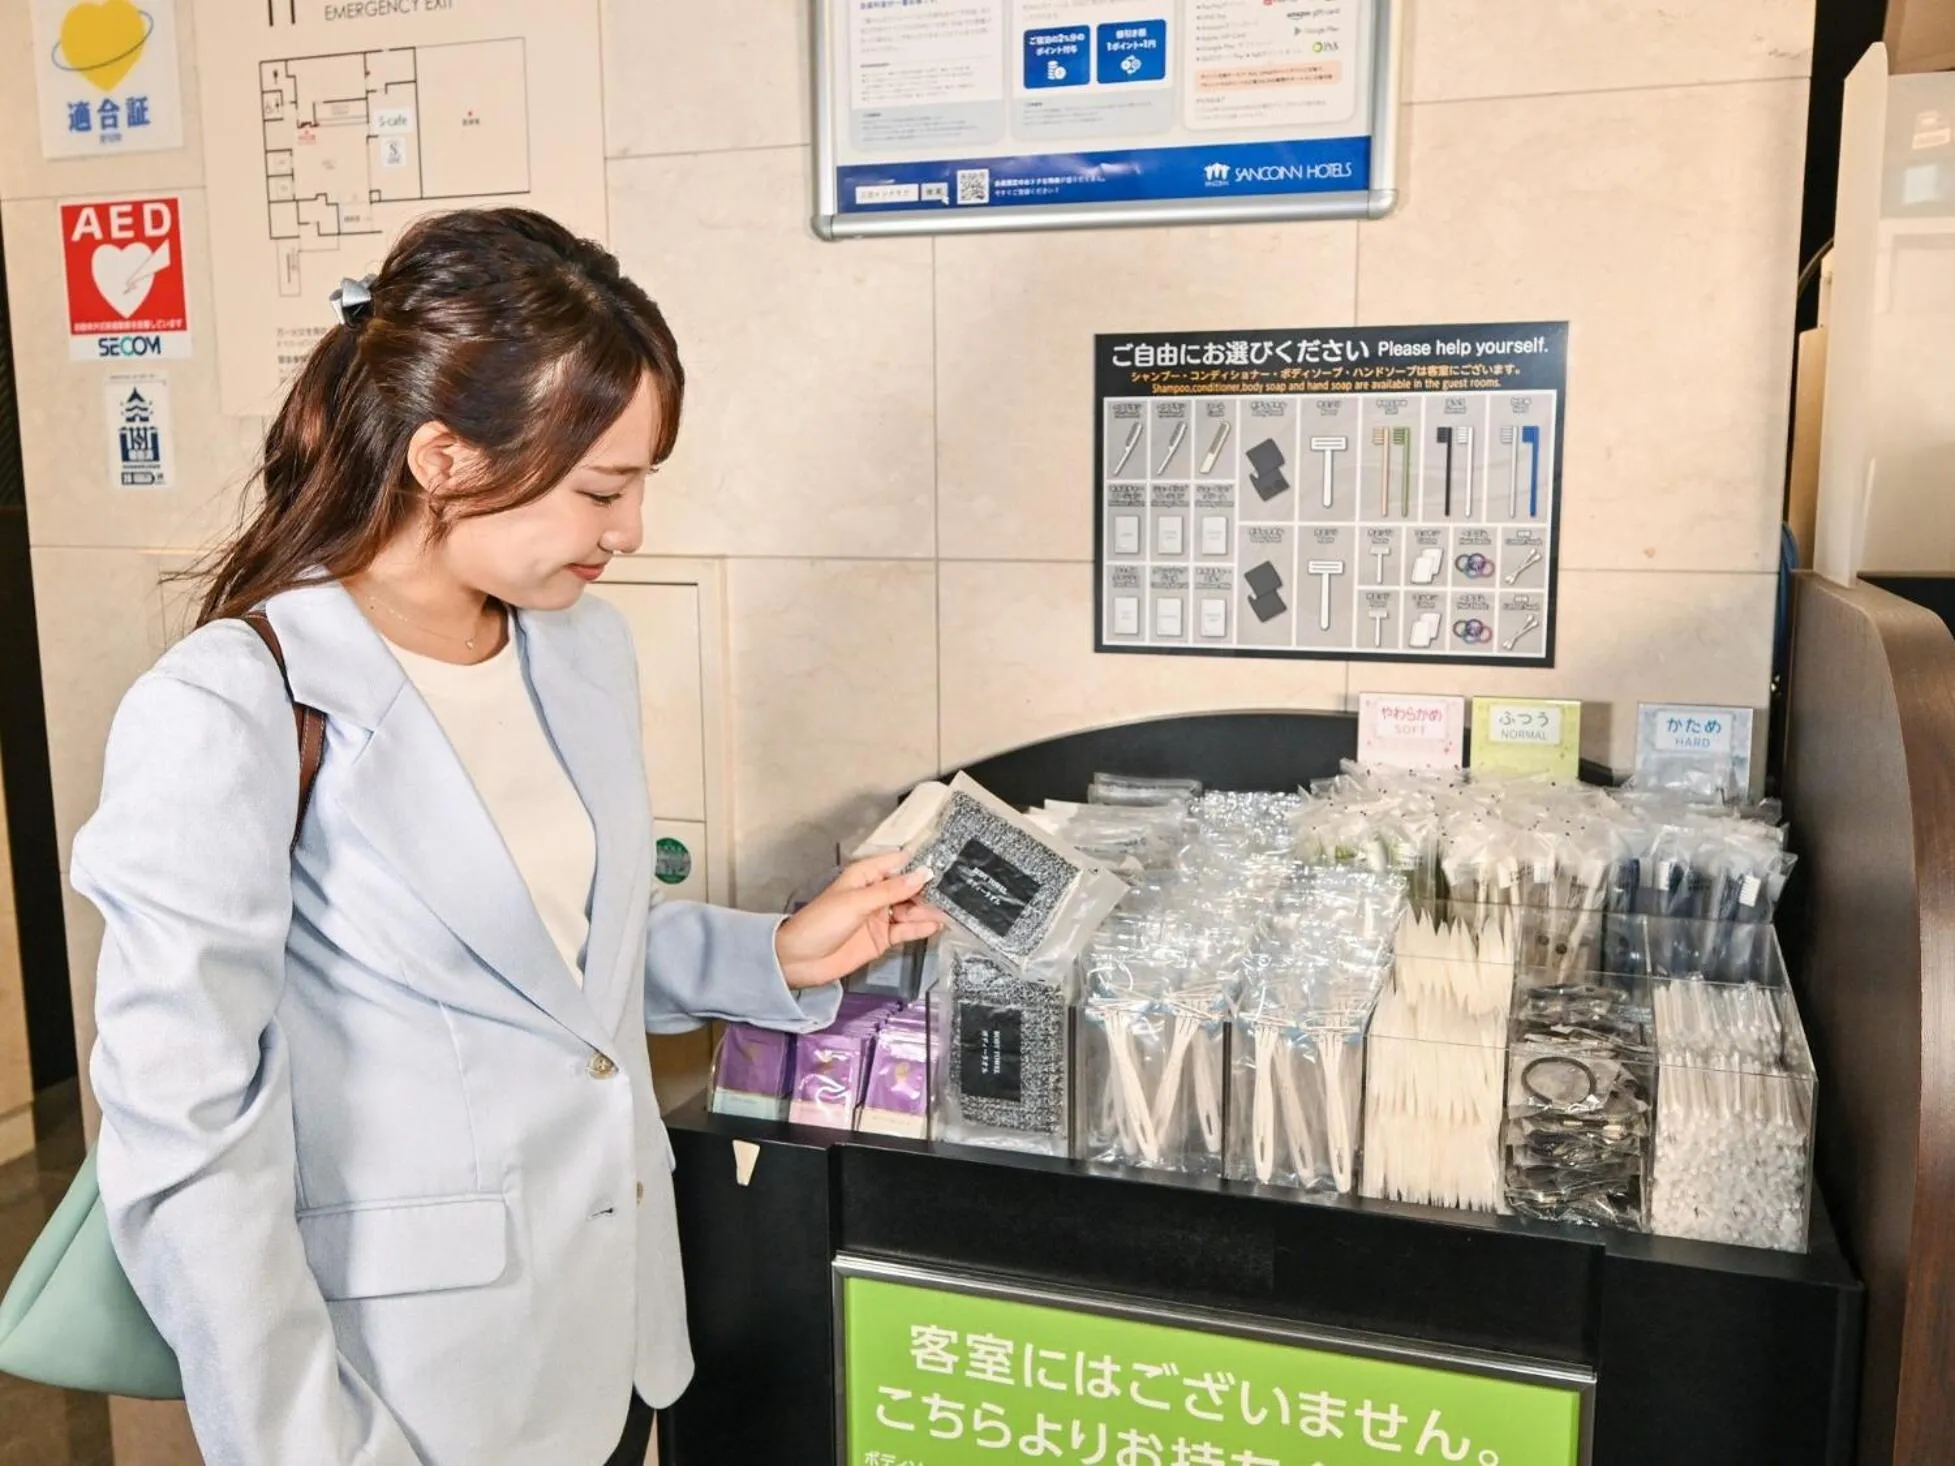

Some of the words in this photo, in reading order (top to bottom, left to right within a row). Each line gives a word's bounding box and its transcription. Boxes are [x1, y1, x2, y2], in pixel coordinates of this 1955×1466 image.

[324, 0, 418, 21] EMERGENCY
[67, 96, 151, 133] 適合証
[1234, 164, 1303, 183] SANCONN
[1307, 162, 1352, 179] HOTELS
[71, 202, 172, 243] AED
[98, 335, 162, 357] SECOM
[1112, 338, 1370, 367] ご自由にお選びください
[1378, 340, 1431, 357] Please
[1436, 338, 1471, 357] help
[1475, 336, 1548, 357] yourself.
[1265, 382, 1287, 393] soap
[1288, 381, 1305, 391] and
[1307, 380, 1329, 391] hand
[1331, 381, 1352, 391] soap
[1354, 381, 1369, 390] are
[1413, 379, 1423, 389] in
[1425, 379, 1440, 389] the
[1442, 379, 1467, 390] guest
[1382, 707, 1442, 722] やわらかめ
[1499, 711, 1550, 727] ふつう
[1395, 724, 1426, 736] SOFT
[1667, 717, 1722, 734] かため
[1501, 730, 1548, 741] NORMAL
[1675, 737, 1711, 748] HARD
[908, 1324, 1499, 1466] 客室にはございません。
